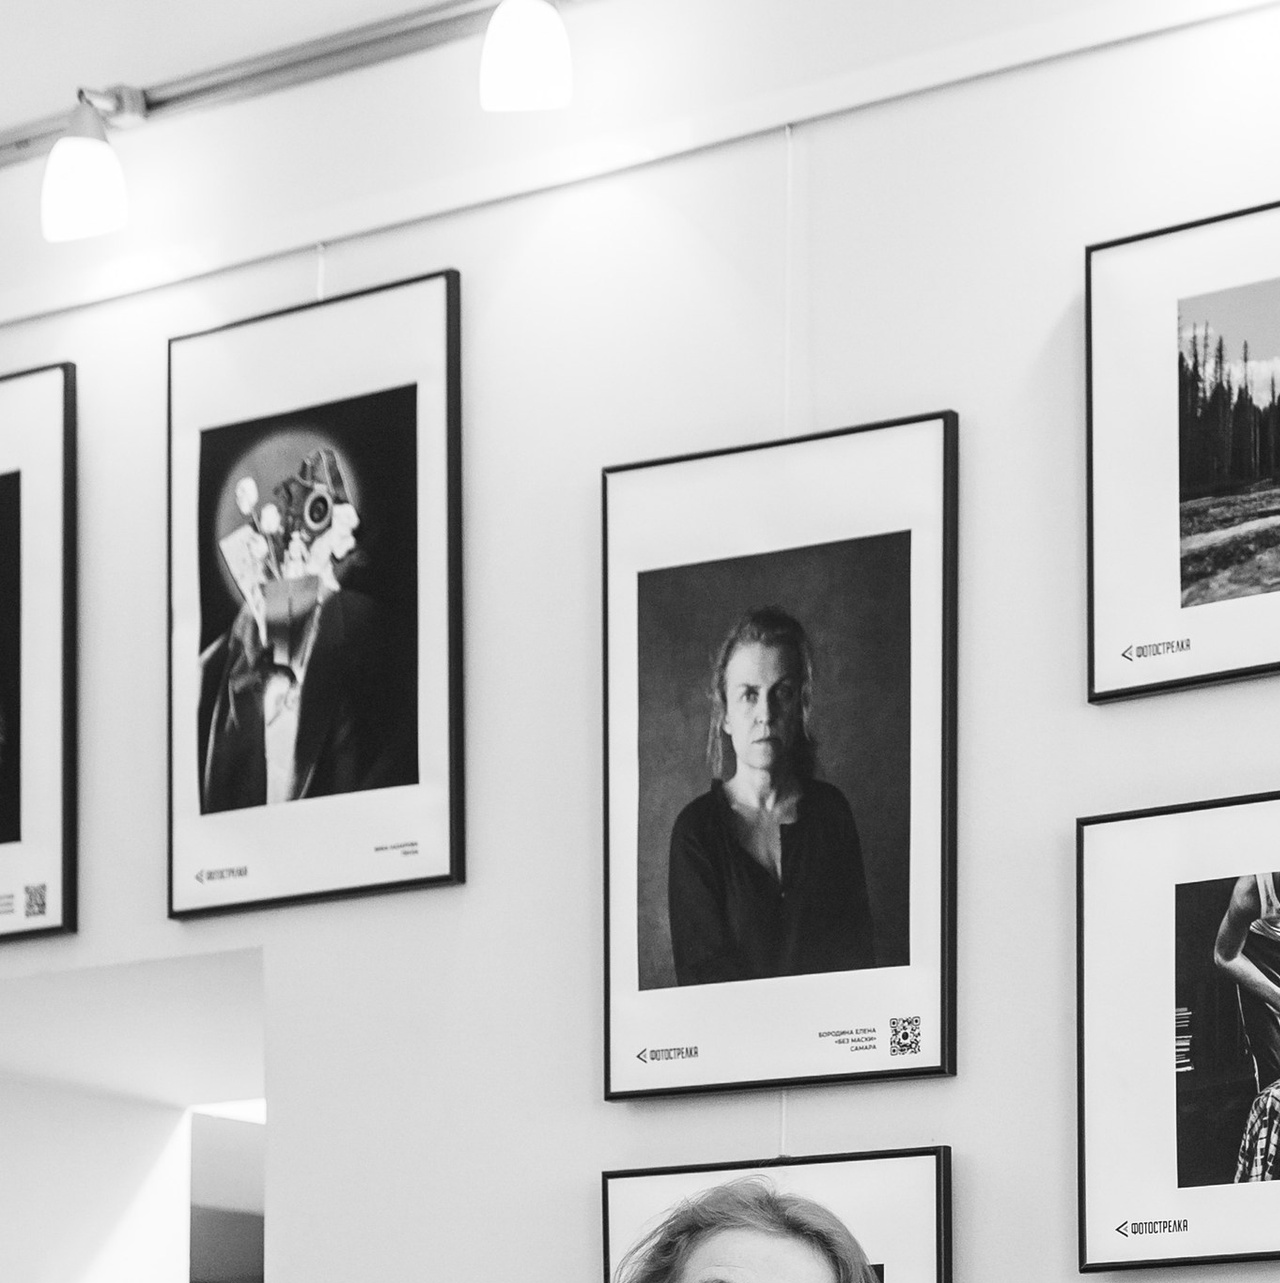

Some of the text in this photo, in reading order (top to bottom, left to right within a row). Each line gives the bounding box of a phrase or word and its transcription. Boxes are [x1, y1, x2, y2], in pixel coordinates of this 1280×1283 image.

[1136, 638, 1191, 659] ФОТОСТРЕЛКА
[818, 1029, 854, 1038] БОРОДИНА
[649, 1046, 699, 1061] ФОТОСТРЕЛКА
[850, 1044, 877, 1052] САМАРА
[1131, 1219, 1188, 1235] ФОТОСТРЕЛКА
